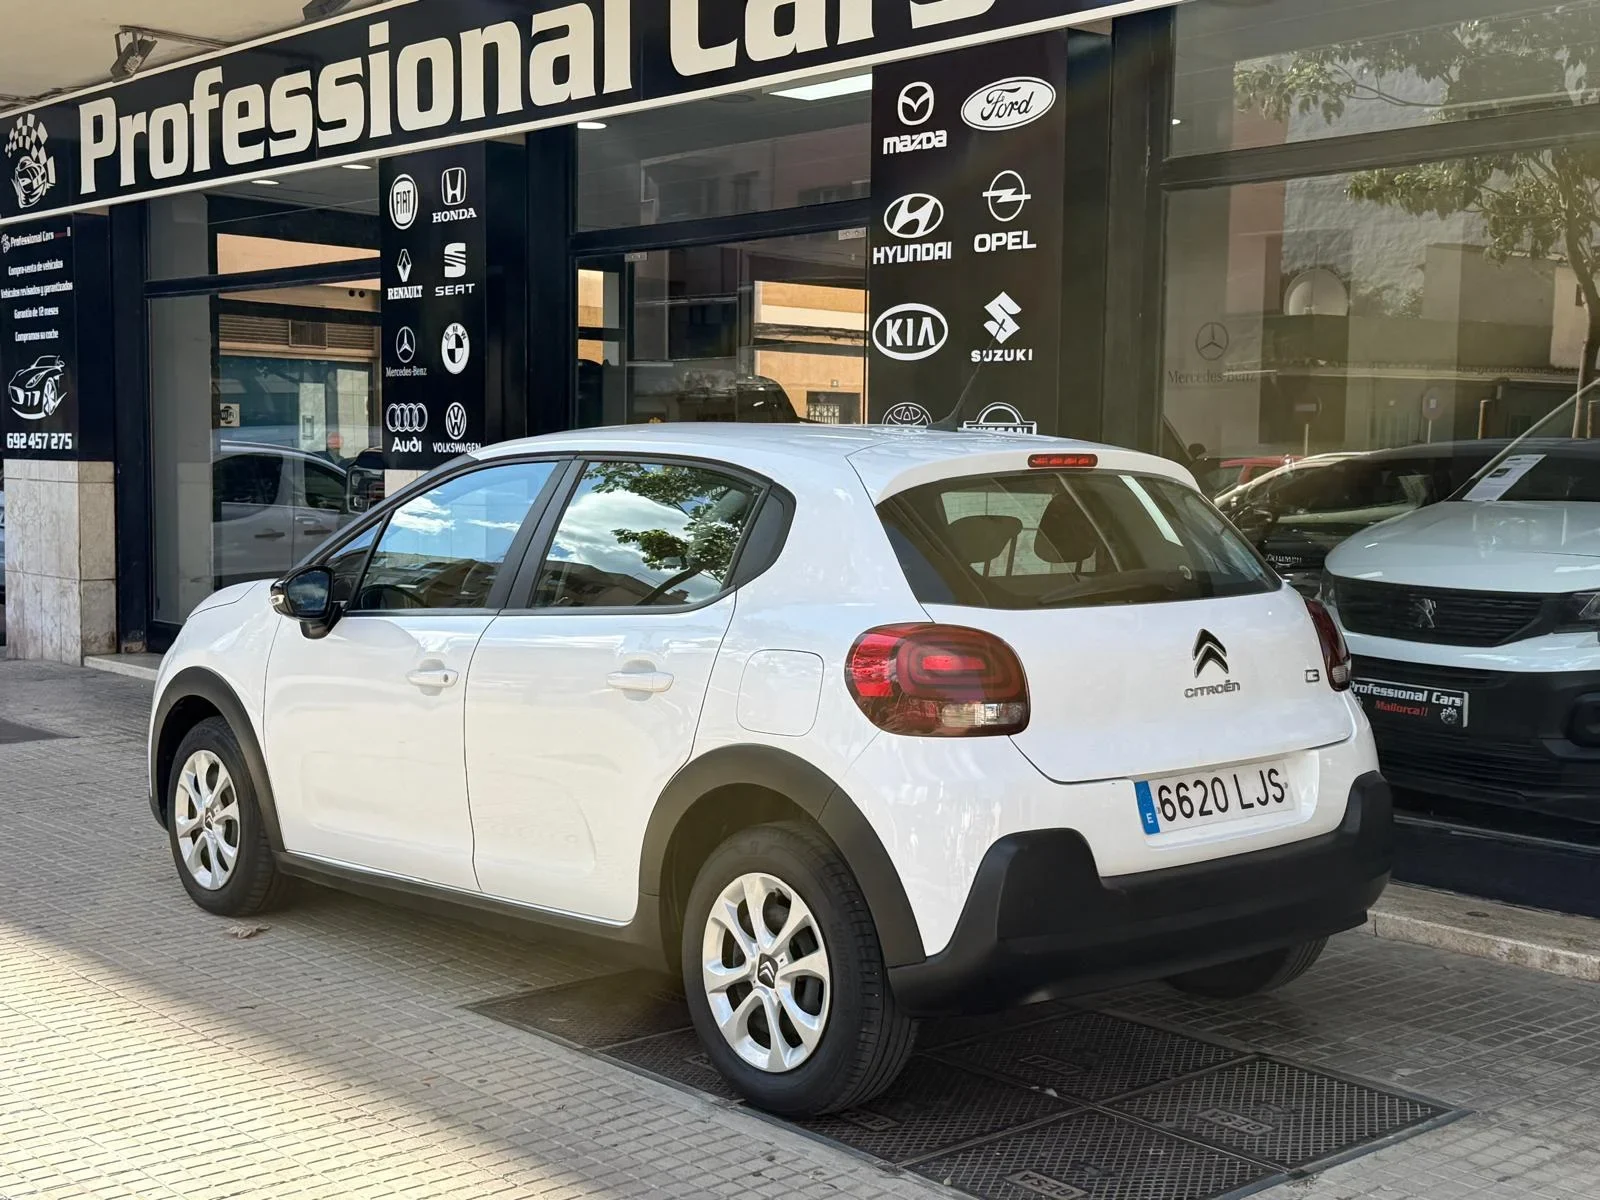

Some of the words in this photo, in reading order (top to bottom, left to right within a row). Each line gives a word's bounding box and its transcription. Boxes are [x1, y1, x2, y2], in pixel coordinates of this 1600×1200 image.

[80, 0, 632, 195] Professional
[980, 86, 1035, 121] Ford
[395, 189, 412, 216] FIAT
[432, 207, 478, 223] HONDA
[10, 231, 42, 247] Professional
[42, 231, 54, 242] Cars
[973, 230, 1037, 253] OPEL
[873, 241, 952, 265] HYUNDAI
[37, 262, 43, 272] de
[387, 285, 423, 300] RENAULT
[435, 283, 476, 297] SEAT
[32, 307, 38, 317] de
[38, 306, 44, 316] 12
[44, 306, 59, 316] meses
[45, 328, 59, 339] coche
[886, 316, 936, 347] KIA
[970, 348, 1033, 363] SUZUKI
[385, 365, 428, 378] Mercedes-Benz
[7, 432, 27, 449] 692
[27, 432, 49, 449] 457
[50, 432, 73, 449] 275
[391, 436, 422, 453] Audi
[432, 442, 482, 453] VOLKSWAGEN
[1431, 691, 1463, 708] Cars
[1157, 777, 1229, 822] 6620
[1233, 768, 1286, 810] LJS
[1145, 813, 1154, 824] E
